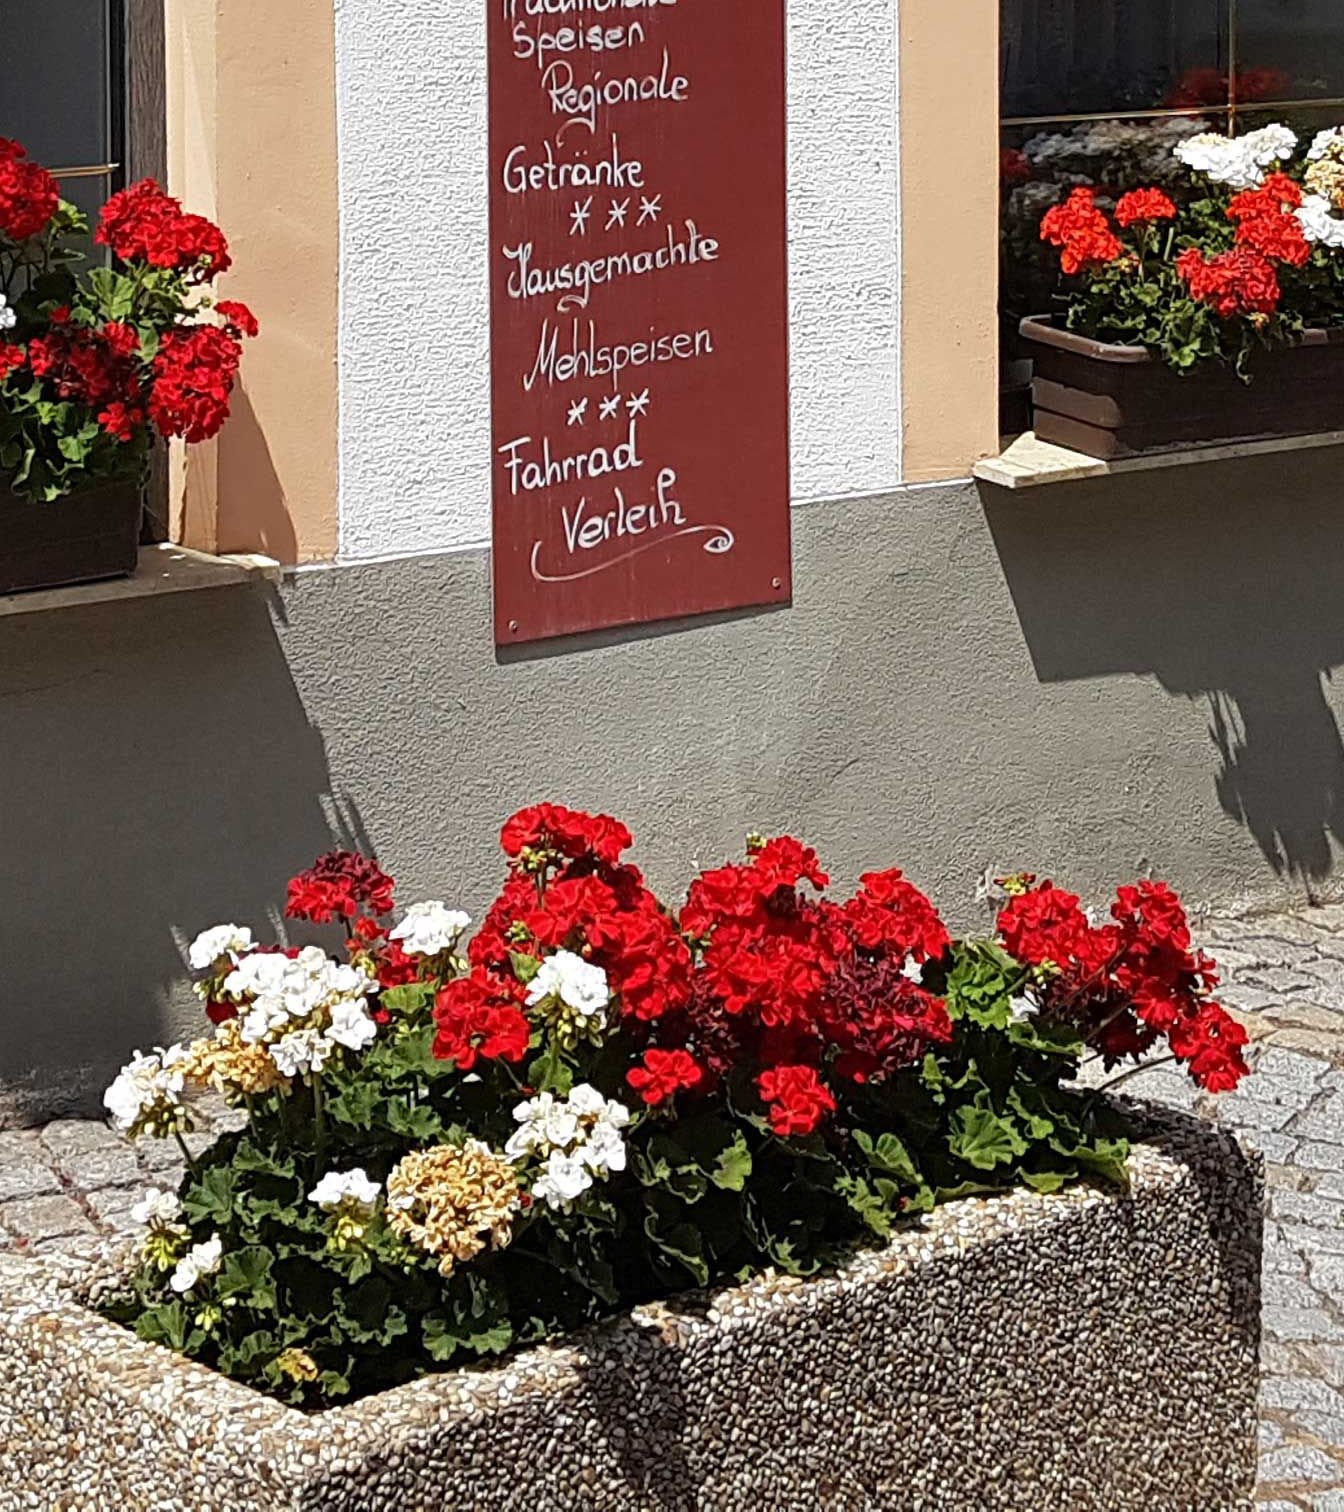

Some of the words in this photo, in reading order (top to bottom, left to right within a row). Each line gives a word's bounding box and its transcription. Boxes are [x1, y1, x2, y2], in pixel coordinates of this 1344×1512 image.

[513, 20, 645, 69] Speisen
[542, 46, 689, 145] Regionale
[502, 133, 645, 193] Getränke
[502, 219, 719, 312] Hausgemachte
[525, 318, 714, 391] Mehlspeisen
[498, 419, 643, 495] Fahrrad
[561, 468, 687, 554] Verleih
